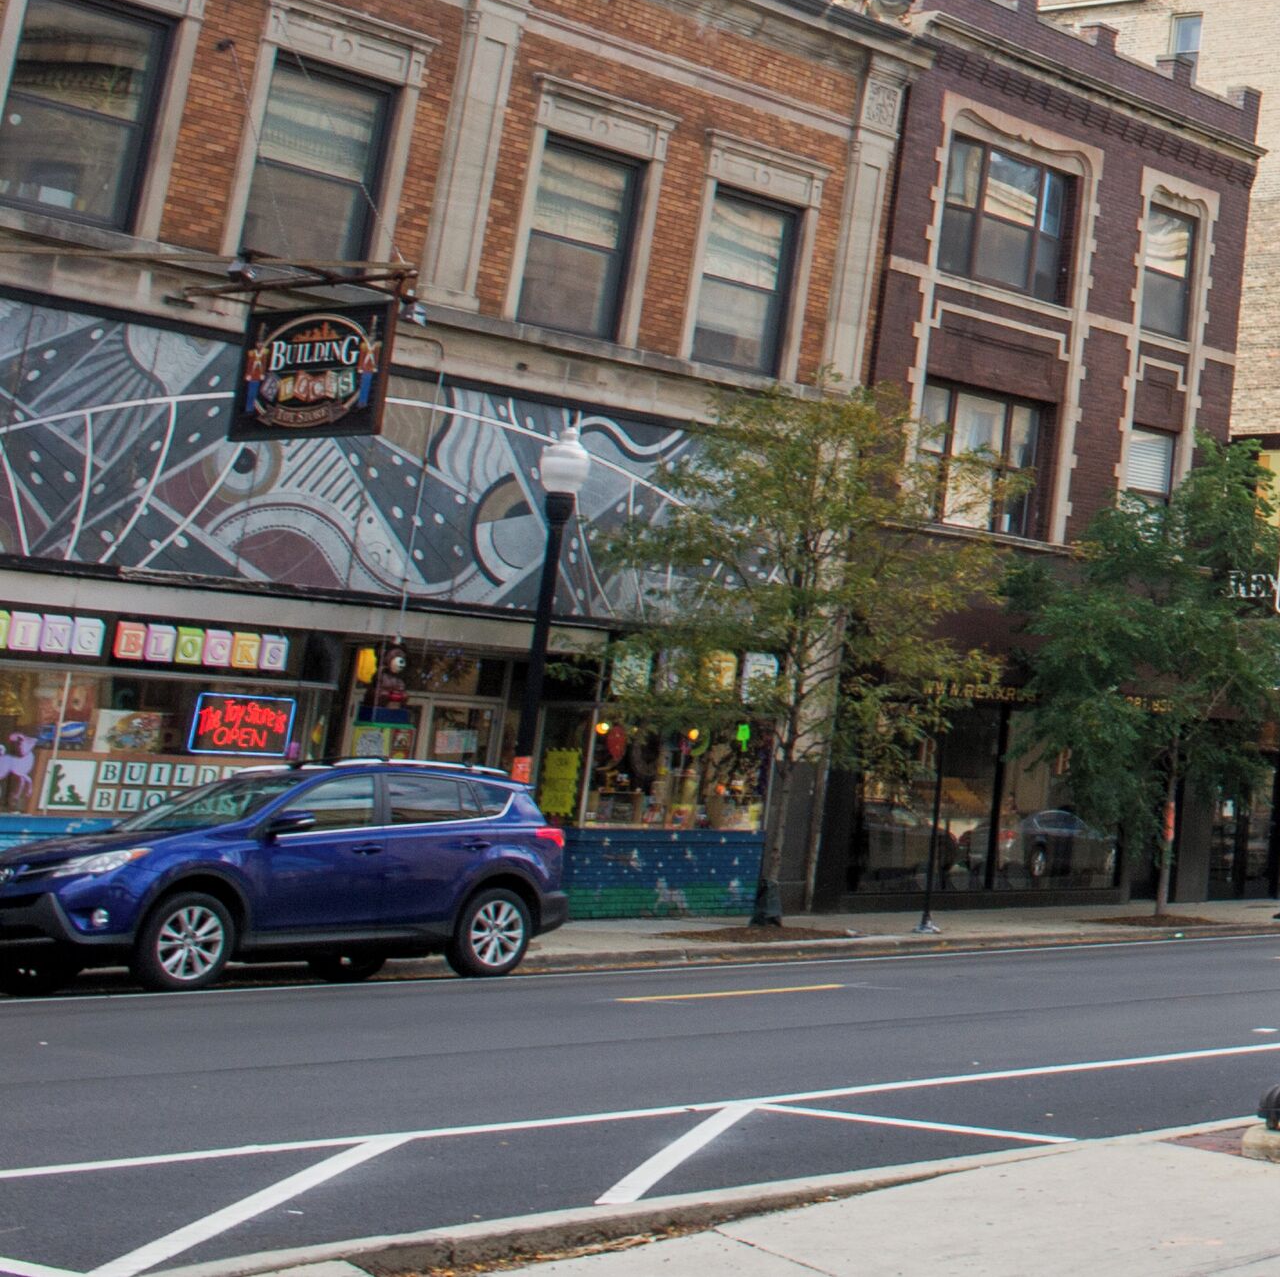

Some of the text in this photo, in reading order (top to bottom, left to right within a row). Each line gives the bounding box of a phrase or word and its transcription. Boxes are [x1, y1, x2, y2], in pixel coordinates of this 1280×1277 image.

[268, 335, 360, 371] BUILDING
[122, 632, 283, 661] BLOCKS
[223, 699, 246, 730] Toy
[245, 701, 276, 728] Store
[212, 726, 269, 749] OPEN
